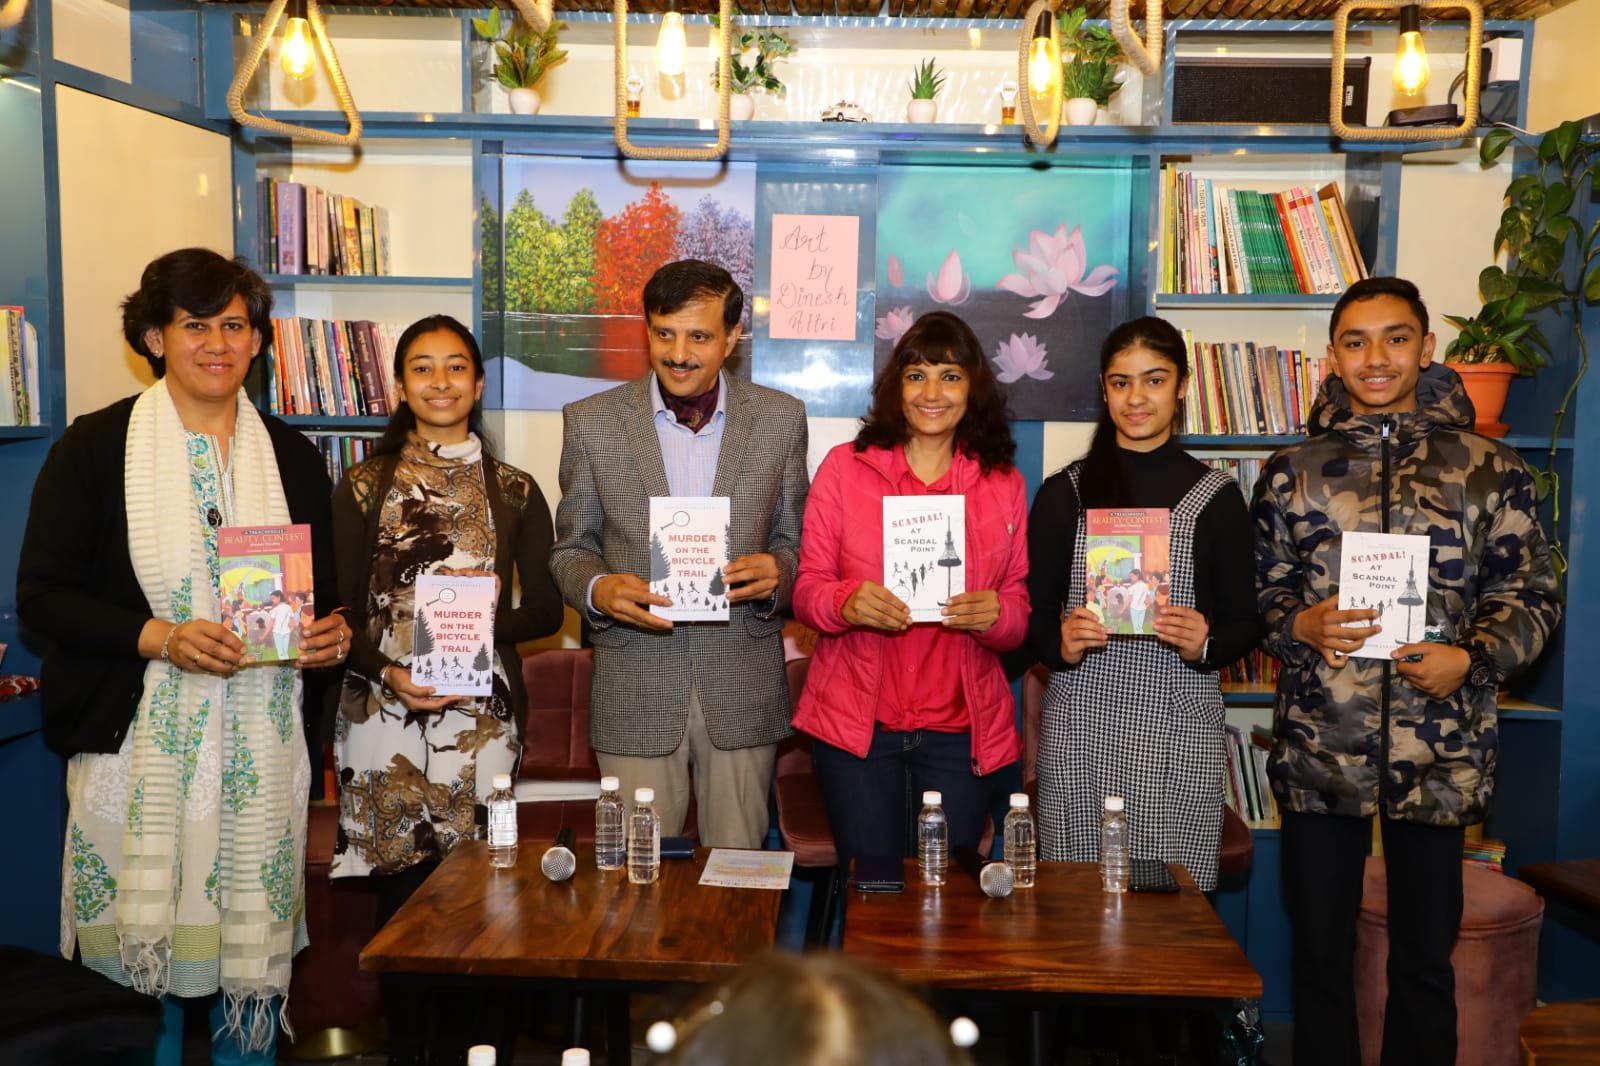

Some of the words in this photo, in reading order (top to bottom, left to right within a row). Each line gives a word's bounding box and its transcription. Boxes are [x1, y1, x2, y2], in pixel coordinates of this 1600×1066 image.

[779, 225, 829, 253] Art
[808, 258, 834, 293] by
[777, 282, 848, 309] Dinesh
[892, 512, 943, 529] SCANDAL!
[1092, 516, 1123, 525] BEAUTY
[1124, 516, 1162, 524] CONTEST
[224, 535, 259, 545] BEAUTY
[262, 531, 304, 542] CONTEST
[668, 534, 716, 542] MURDER
[671, 557, 716, 565] BICYCLE
[1351, 551, 1406, 564] SCANDAL!
[1352, 573, 1398, 582] SCANDAL
[433, 611, 482, 619] MURDER
[436, 633, 481, 641] BICYCLE
[441, 645, 472, 653] TRAIL
